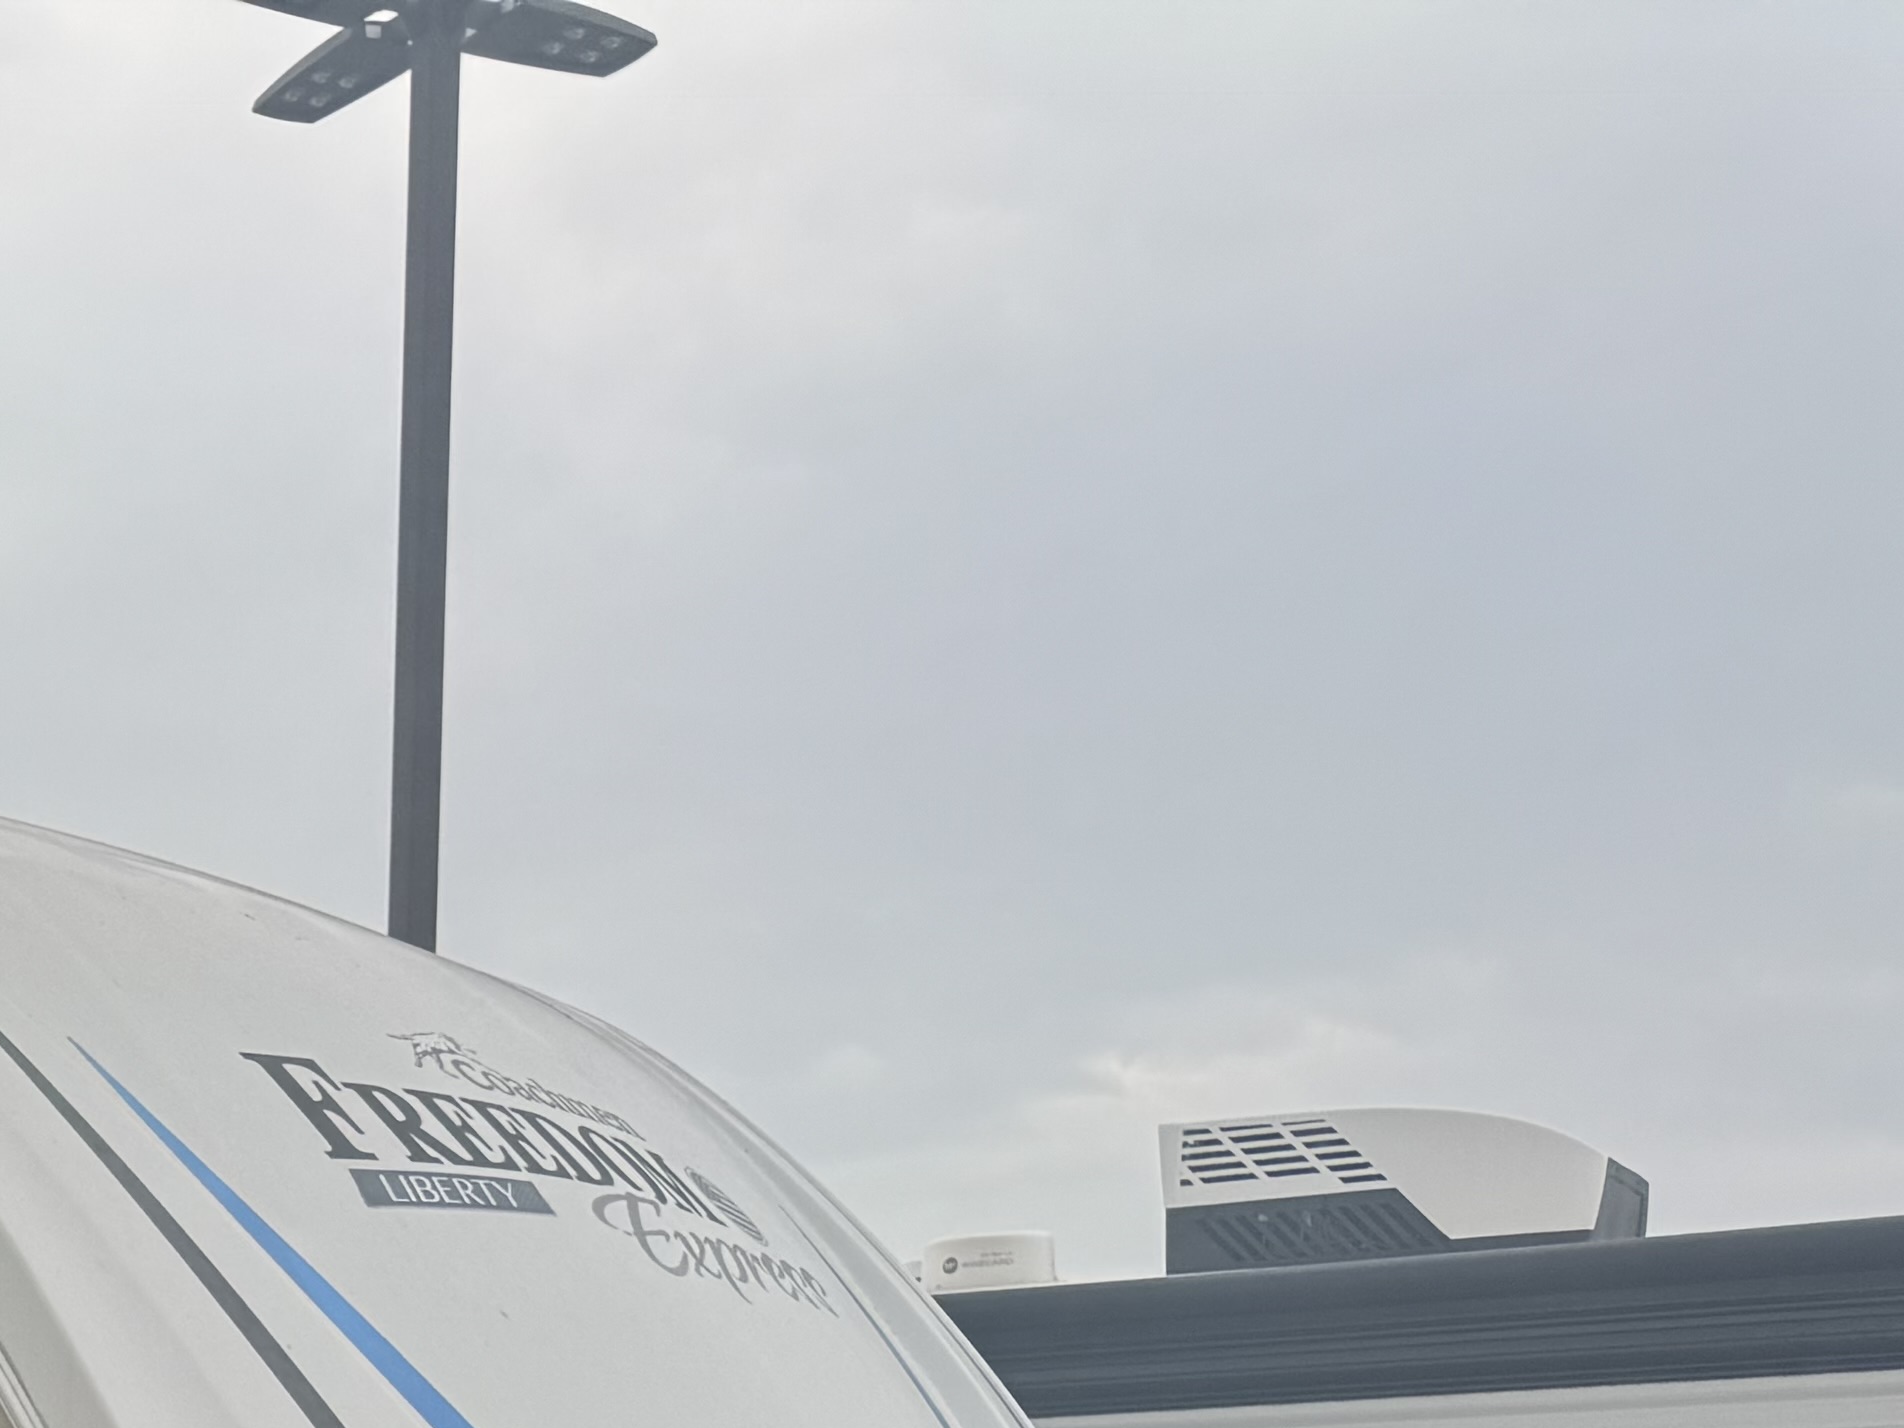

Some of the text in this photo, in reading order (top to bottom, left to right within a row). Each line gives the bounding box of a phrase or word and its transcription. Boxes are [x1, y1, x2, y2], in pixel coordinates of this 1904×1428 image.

[239, 1051, 728, 1227] FREEDOM
[450, 1055, 646, 1142] Coachmen
[377, 1174, 522, 1208] LIBERTY
[592, 1191, 840, 1318] Express
